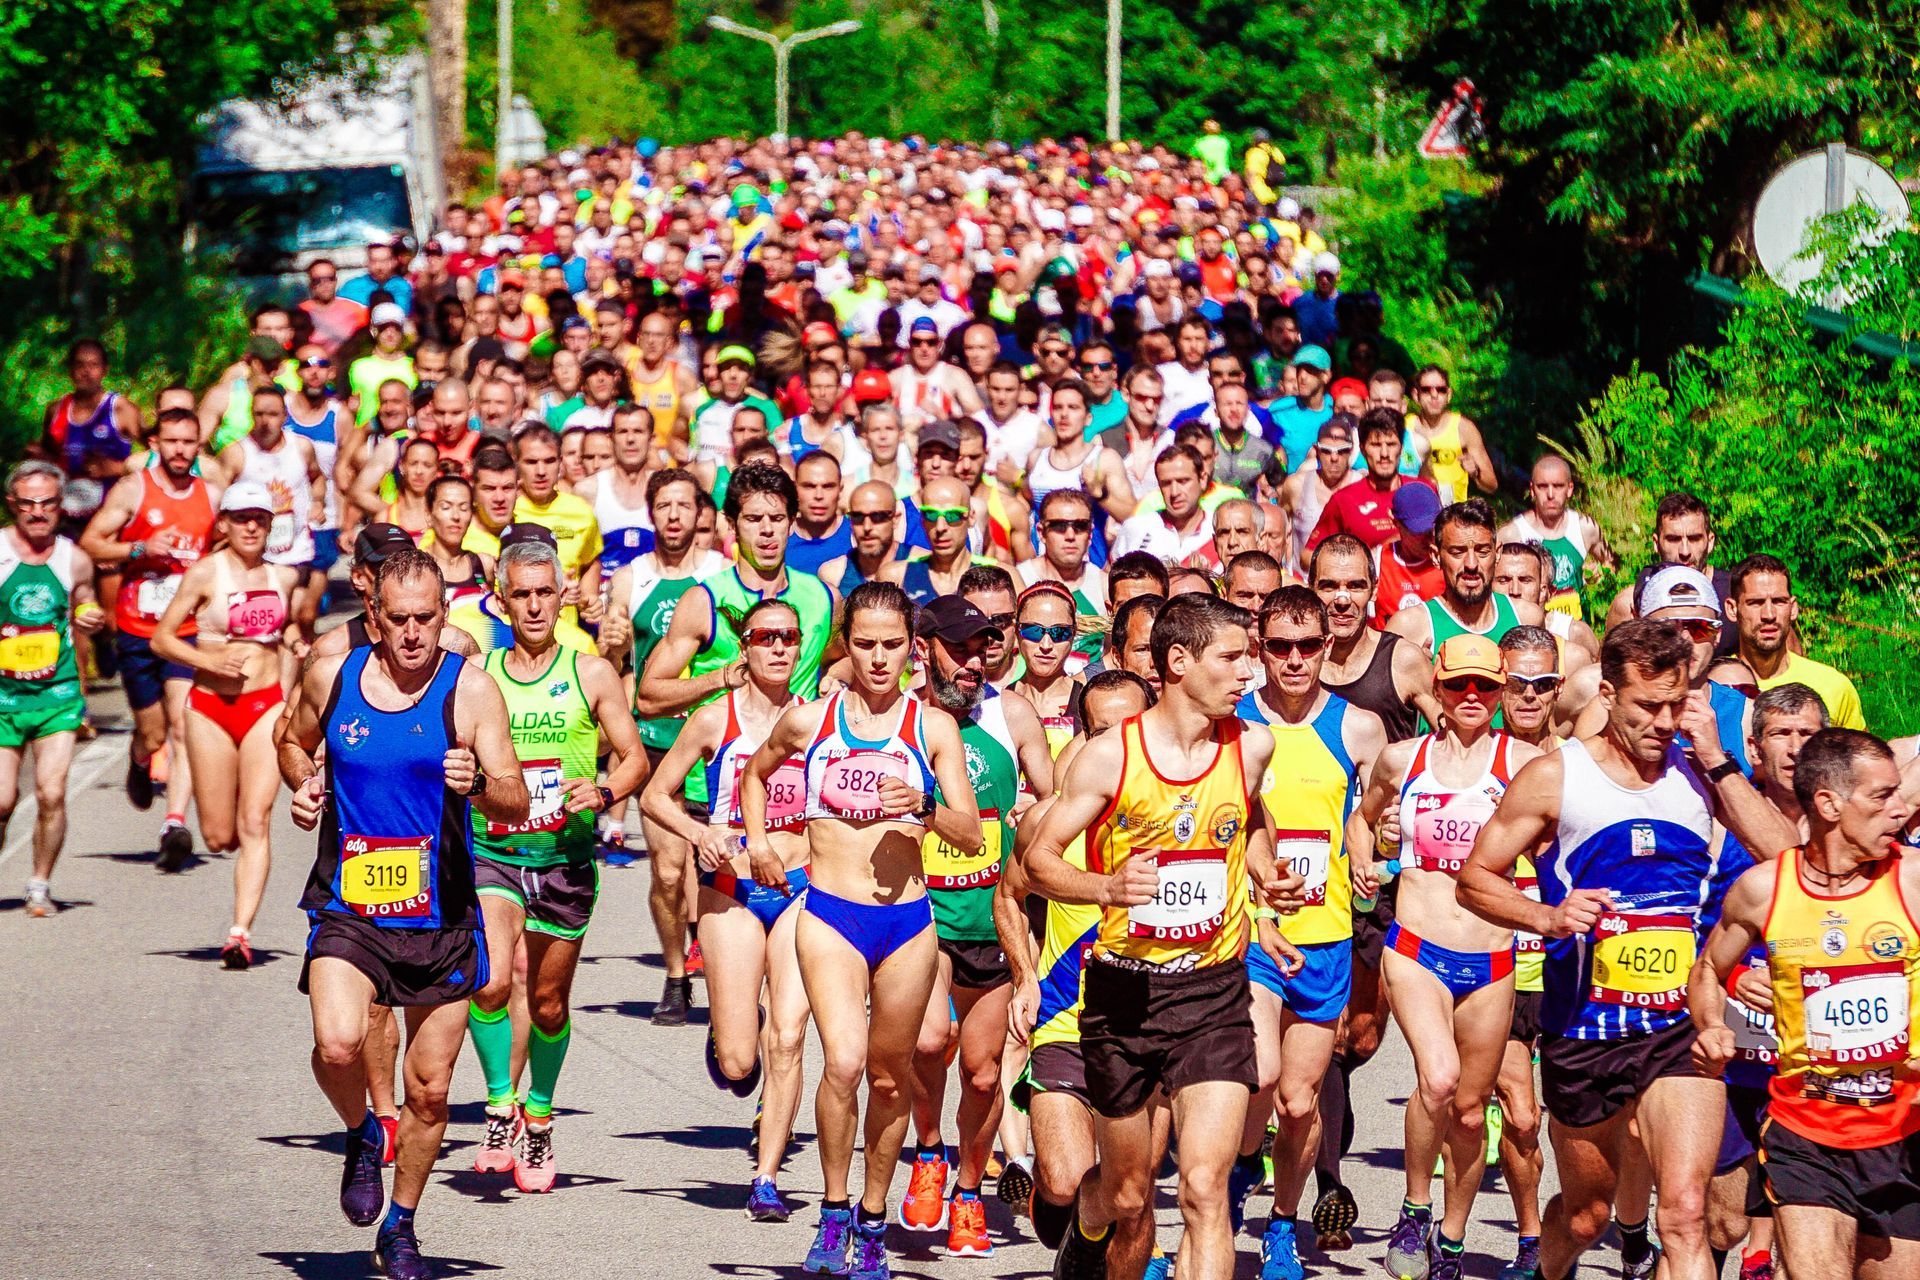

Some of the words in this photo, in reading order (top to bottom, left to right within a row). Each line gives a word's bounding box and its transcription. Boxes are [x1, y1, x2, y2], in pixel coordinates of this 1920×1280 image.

[241, 609, 275, 627] 4685
[511, 711, 566, 730] LDAS
[1418, 796, 1442, 810] edp
[1433, 819, 1481, 842] 3827
[345, 838, 368, 855] edp
[937, 836, 987, 859] 406
[945, 862, 1000, 887] DOURO
[1438, 858, 1466, 871] DO
[364, 865, 407, 886] 3119
[366, 892, 429, 915] DOURO
[1155, 913, 1224, 940] DOURO
[1600, 916, 1628, 935] edp
[1617, 946, 1677, 974] 4620
[1803, 970, 1831, 990] edp
[1825, 997, 1889, 1027] 4686
[1745, 1049, 1779, 1062] DO
[1836, 1031, 1909, 1062] DOURO
